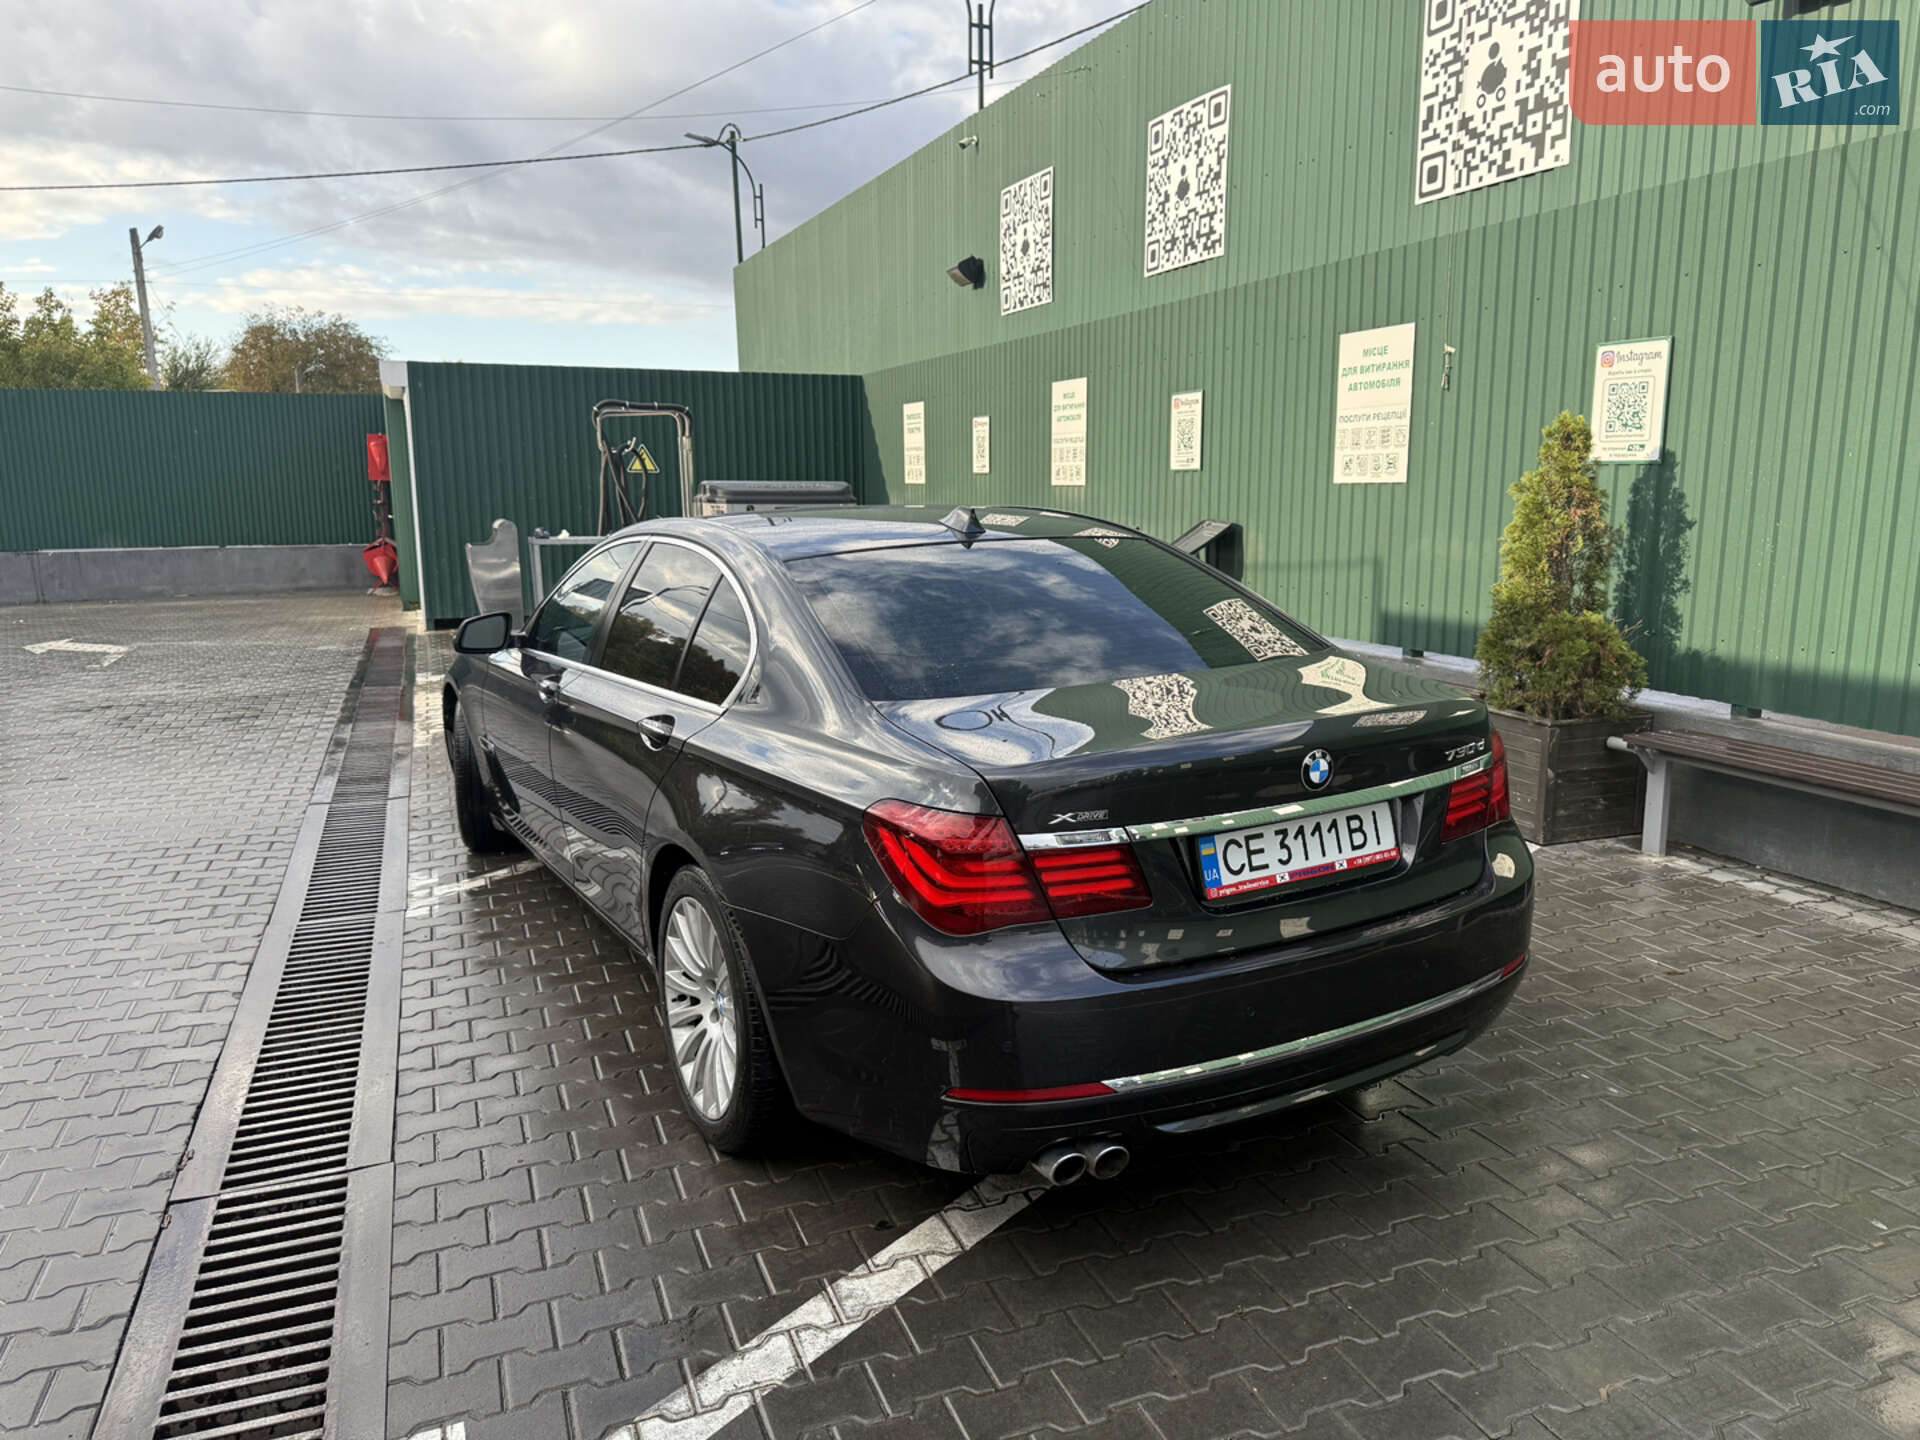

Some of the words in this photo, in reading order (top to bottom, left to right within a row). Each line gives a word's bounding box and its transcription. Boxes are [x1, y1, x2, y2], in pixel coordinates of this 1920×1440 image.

[1362, 345, 1389, 358] МІСЦЕ
[1615, 349, 1663, 366] Instagram
[1341, 366, 1358, 378] ДЛЯ
[1360, 359, 1411, 375] ВИТИРАННЯ
[1347, 377, 1401, 392] АВТОМОБІЛЯ
[1204, 868, 1220, 881] UA
